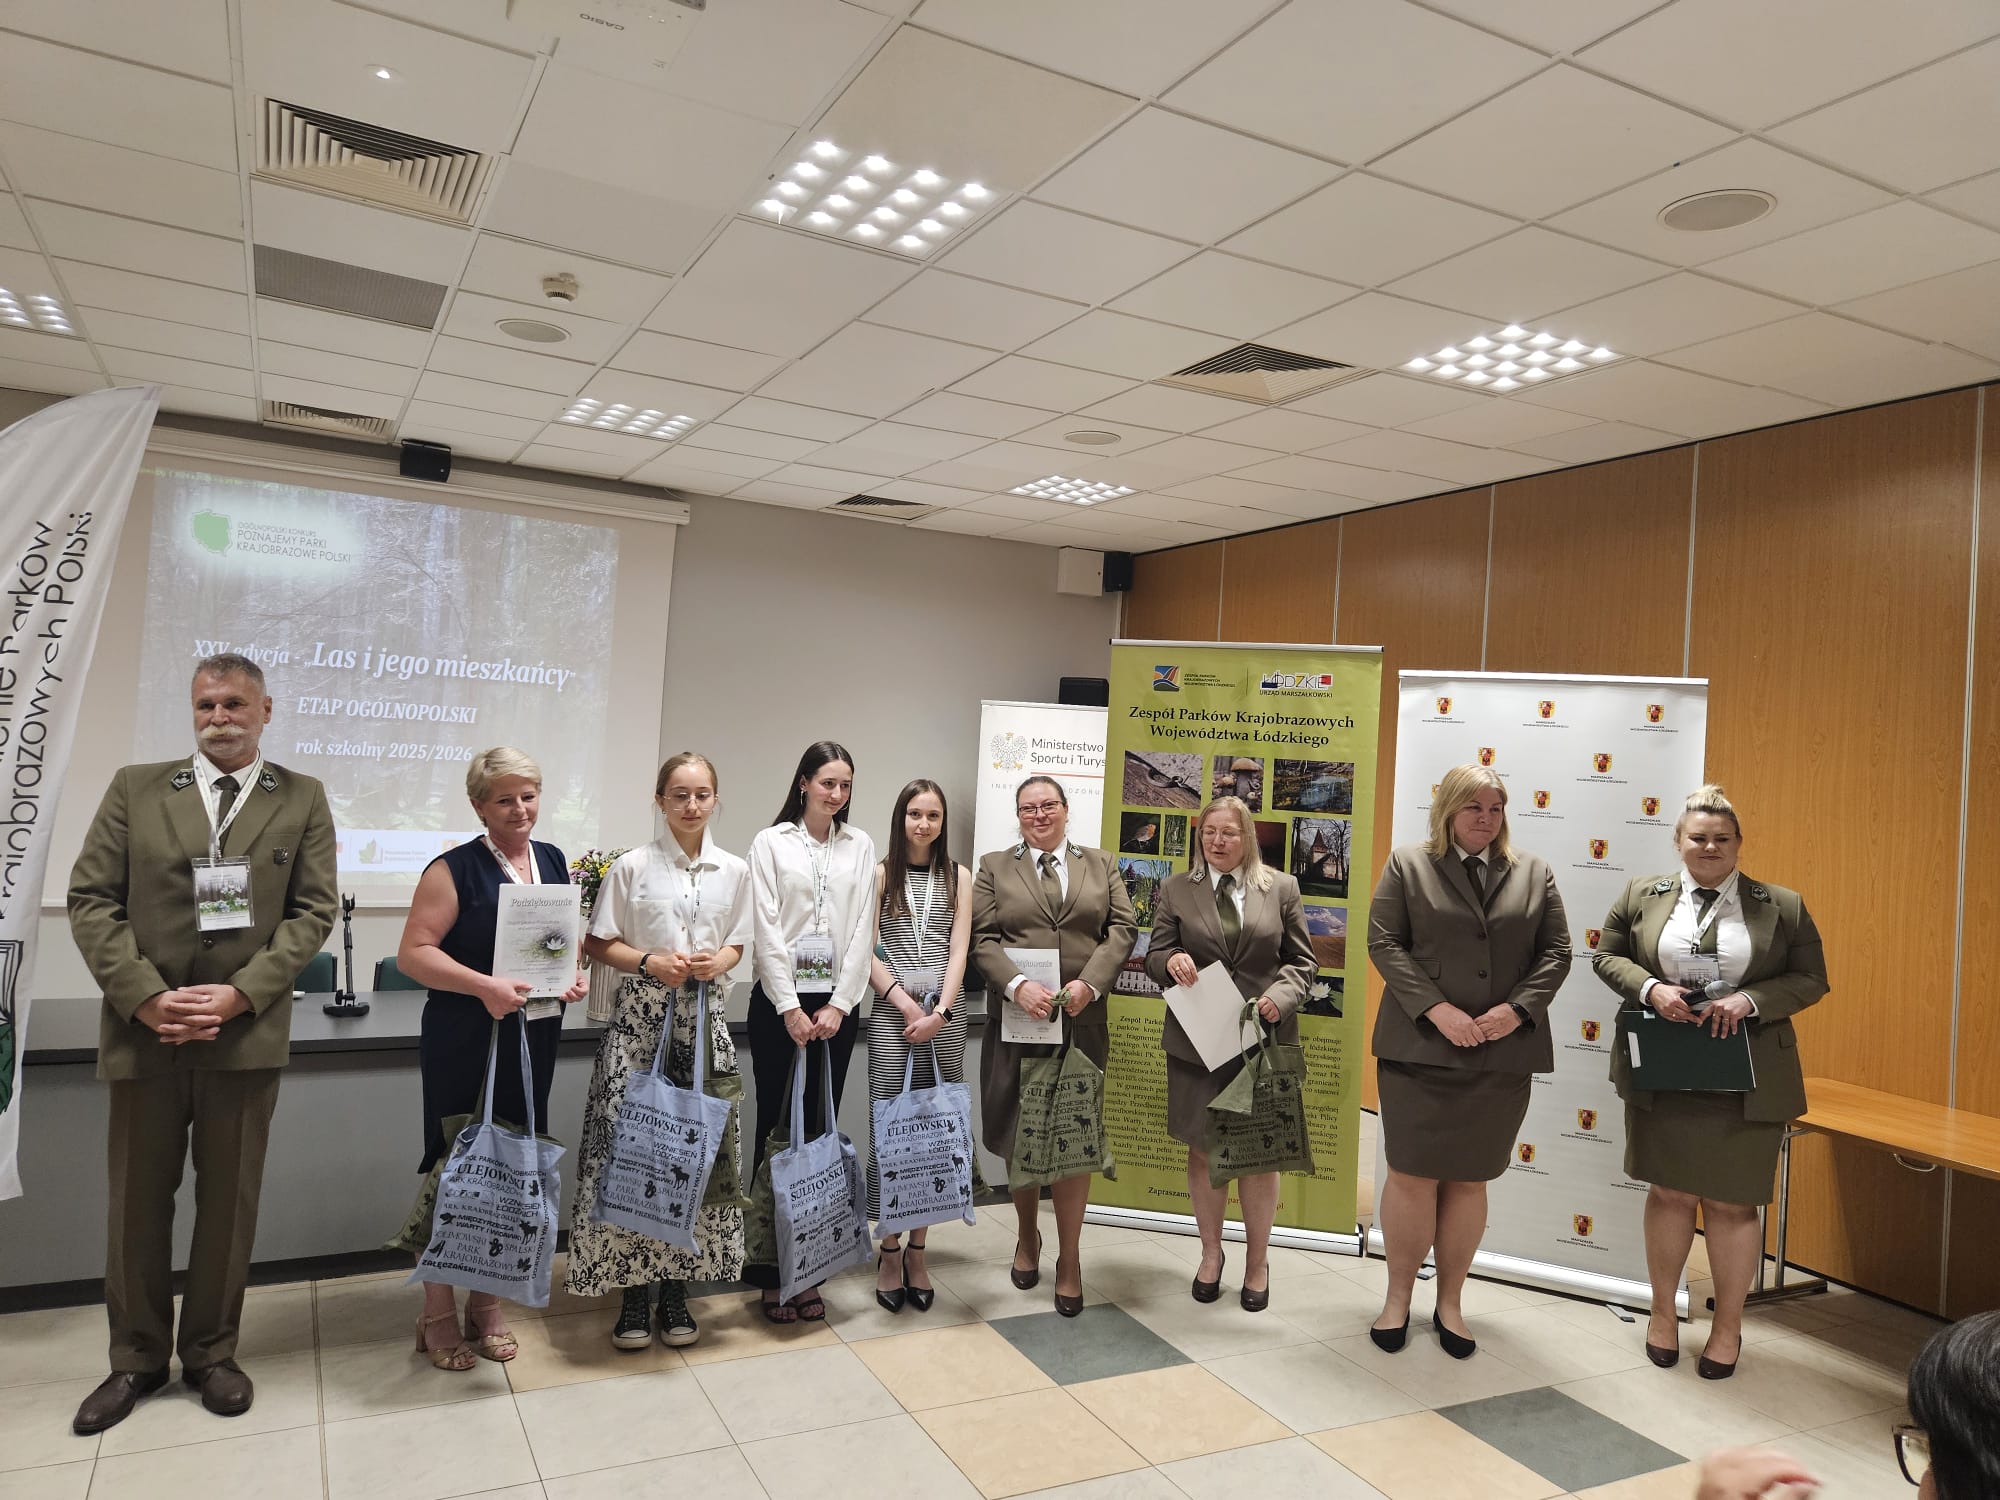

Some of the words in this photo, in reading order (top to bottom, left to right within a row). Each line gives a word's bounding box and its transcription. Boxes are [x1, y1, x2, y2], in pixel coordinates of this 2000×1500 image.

[237, 530, 296, 545] POZNAJEMY
[300, 538, 327, 548] PARKI
[237, 542, 317, 560] KRAJOBRAZOWE
[319, 551, 351, 563] POLSKI
[363, 646, 373, 670] i
[373, 647, 429, 680] jego
[1281, 690, 1333, 698] MARSZAŁKOWSKI
[296, 696, 342, 716] ETAP
[346, 697, 478, 724] OGÓLNOPOLSKI
[1129, 706, 1175, 721] Zespół
[1179, 708, 1231, 722] Parków
[1235, 711, 1354, 731] Krajobrazowych
[1031, 738, 1104, 752] Ministerstwo
[1150, 724, 1249, 741] Województwa
[1253, 729, 1329, 748] Łódzkiego
[295, 739, 323, 755] rok
[326, 740, 386, 762] szkolny
[387, 742, 473, 762] 2025/2026
[1030, 752, 1068, 765] Sportu
[1070, 754, 1074, 765] i
[1077, 755, 1107, 769] Turys
[1116, 1023, 1139, 1031] parków
[1120, 1015, 1141, 1024] Zespół
[1133, 1093, 1168, 1102] przyrodnic
[619, 1108, 682, 1136] ULEJOWSKI
[887, 1119, 951, 1138] ULEJOWSKI
[456, 1163, 526, 1190] ULEJOWSKI
[1162, 1163, 1187, 1172] przyrod
[1148, 1187, 1191, 1200] Zapraszamy
